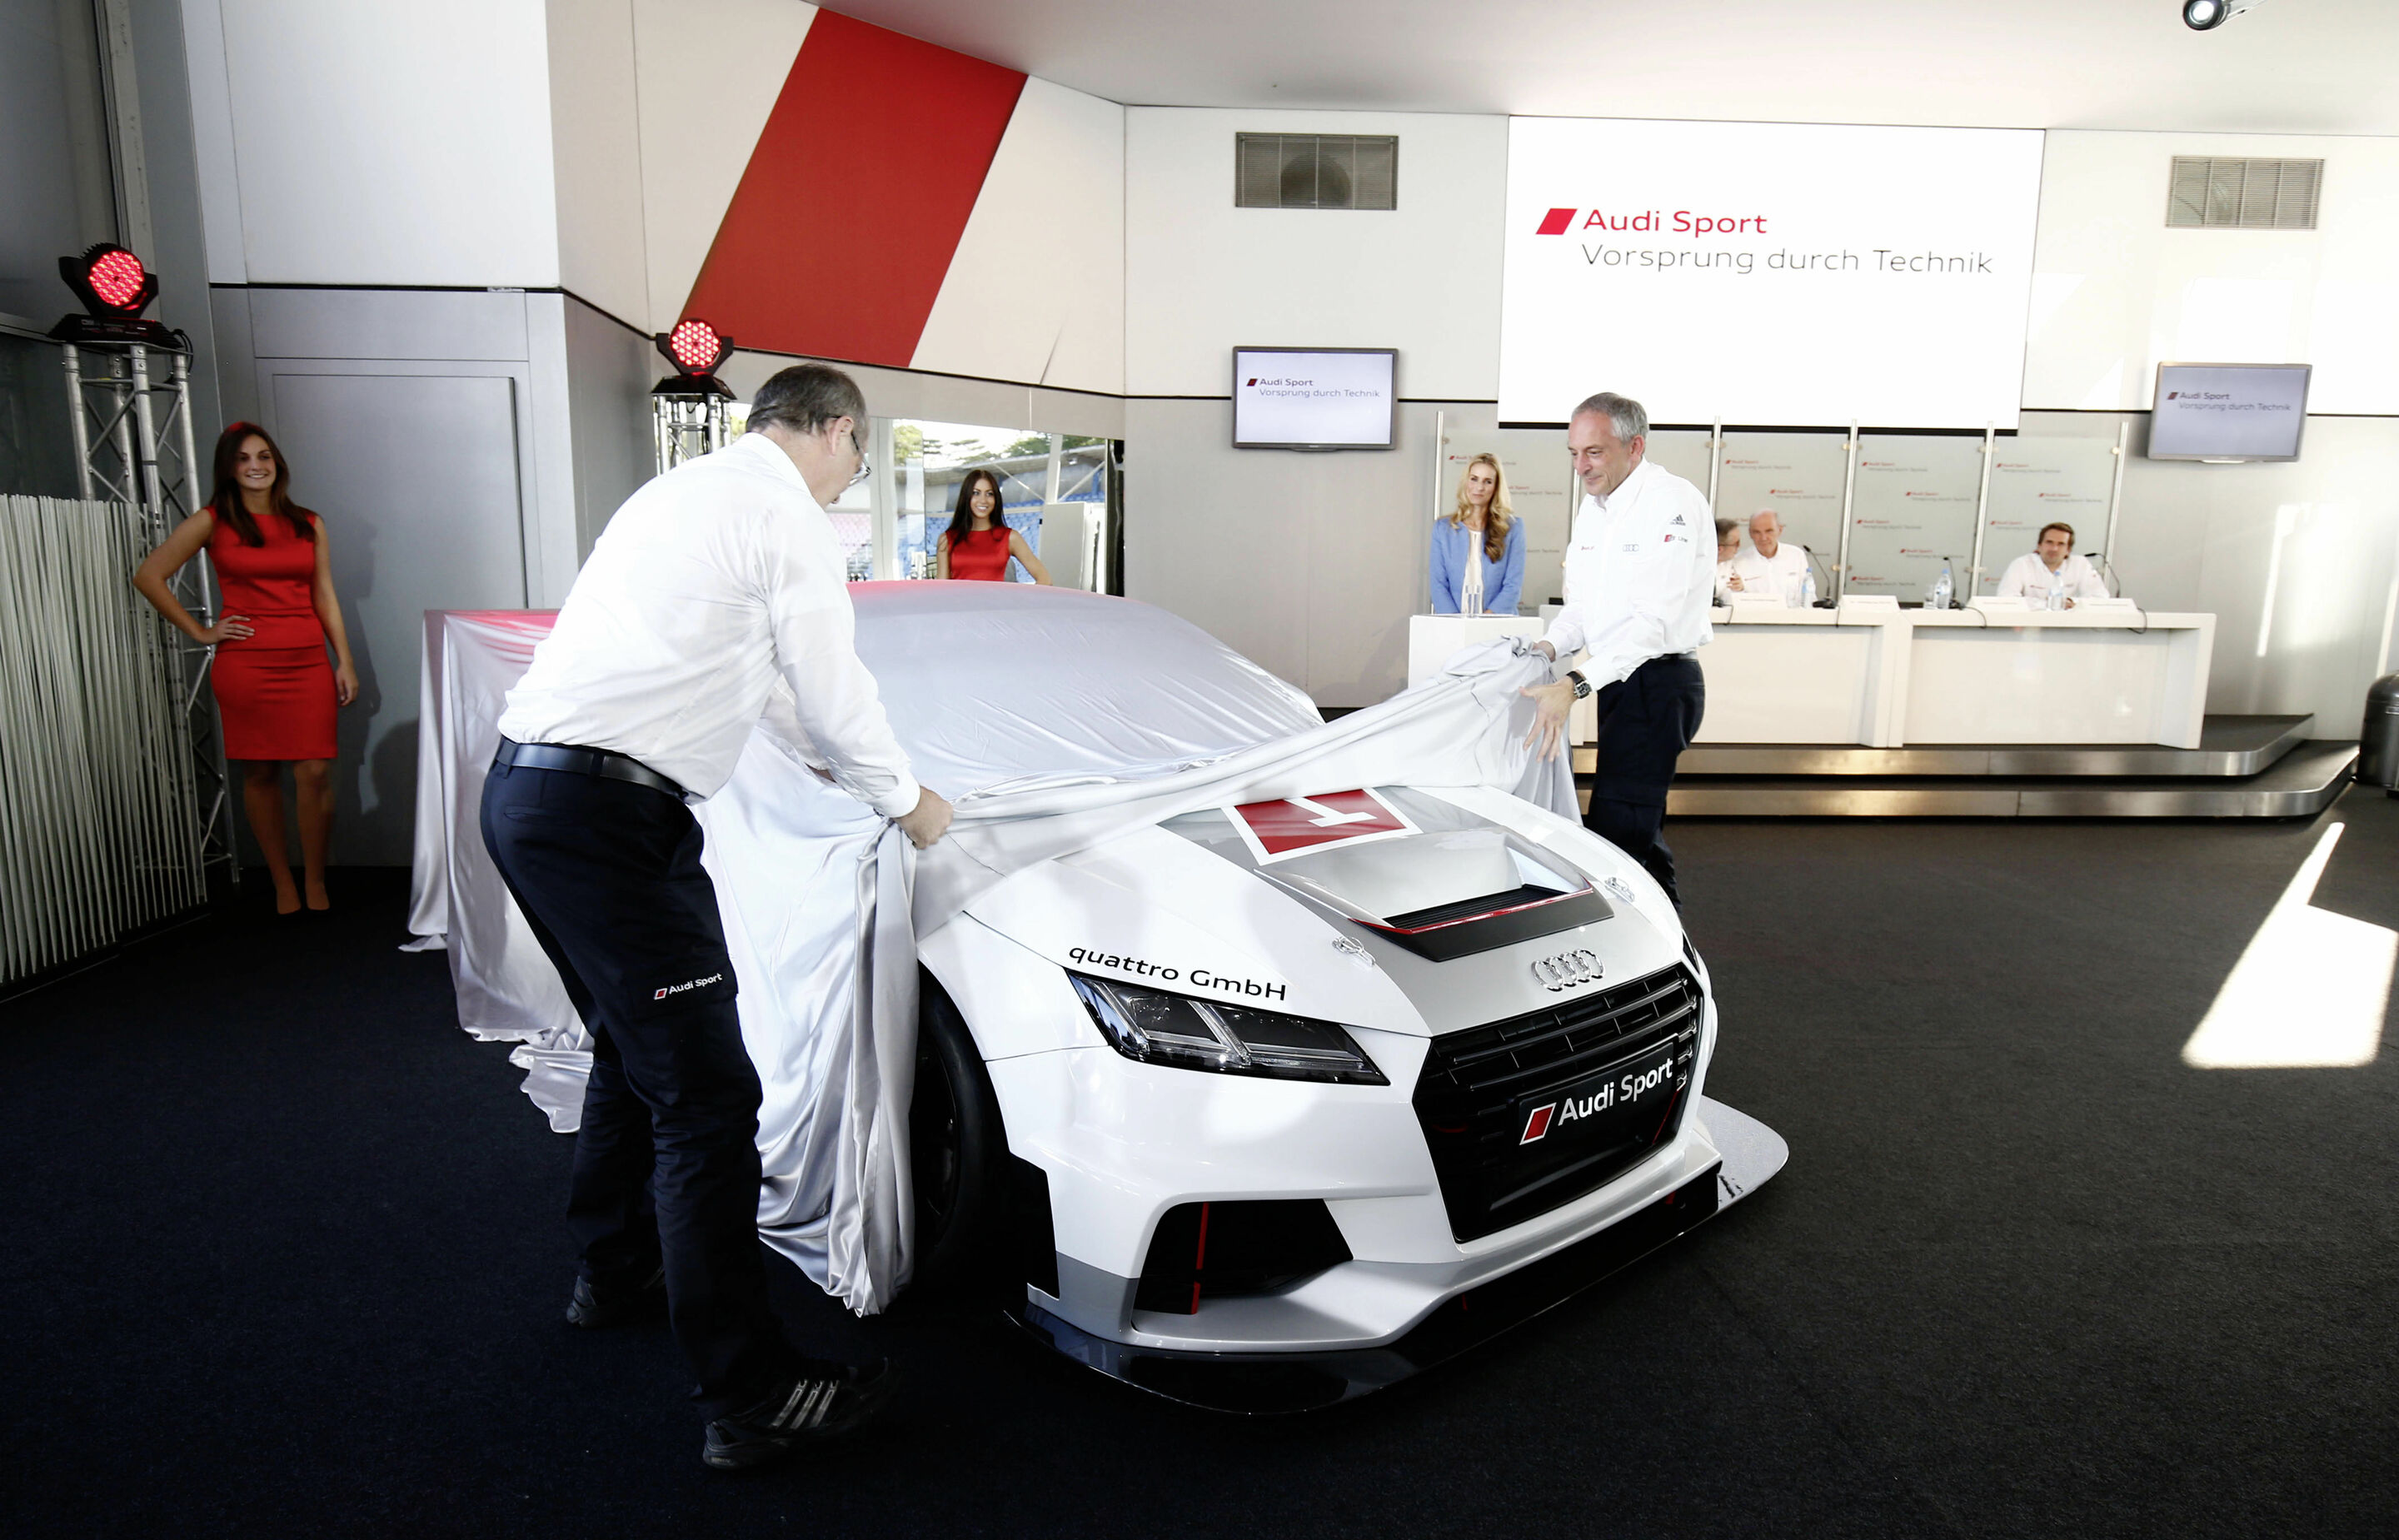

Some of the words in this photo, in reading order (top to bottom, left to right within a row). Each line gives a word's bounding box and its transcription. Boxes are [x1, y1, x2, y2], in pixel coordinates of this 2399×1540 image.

[1584, 209, 1660, 232] Audi
[1673, 211, 1768, 237] Sport
[1582, 244, 1753, 274] Vorsprung
[1767, 248, 1859, 271] durch
[1873, 250, 1993, 273] Technik
[1259, 389, 1309, 398] Vorsprung
[1314, 389, 1341, 397] durch
[1285, 379, 1313, 387] Sport
[2179, 402, 2226, 411] Vorsprung
[2257, 403, 2292, 411] Technik
[2203, 392, 2230, 401] Sport
[669, 981, 694, 994] Audi
[695, 973, 722, 987] Sport
[1069, 947, 1180, 980] quattro
[1190, 969, 1287, 1001] GmbH
[1558, 1082, 1614, 1126] Audi
[1620, 1057, 1673, 1102] Sport
